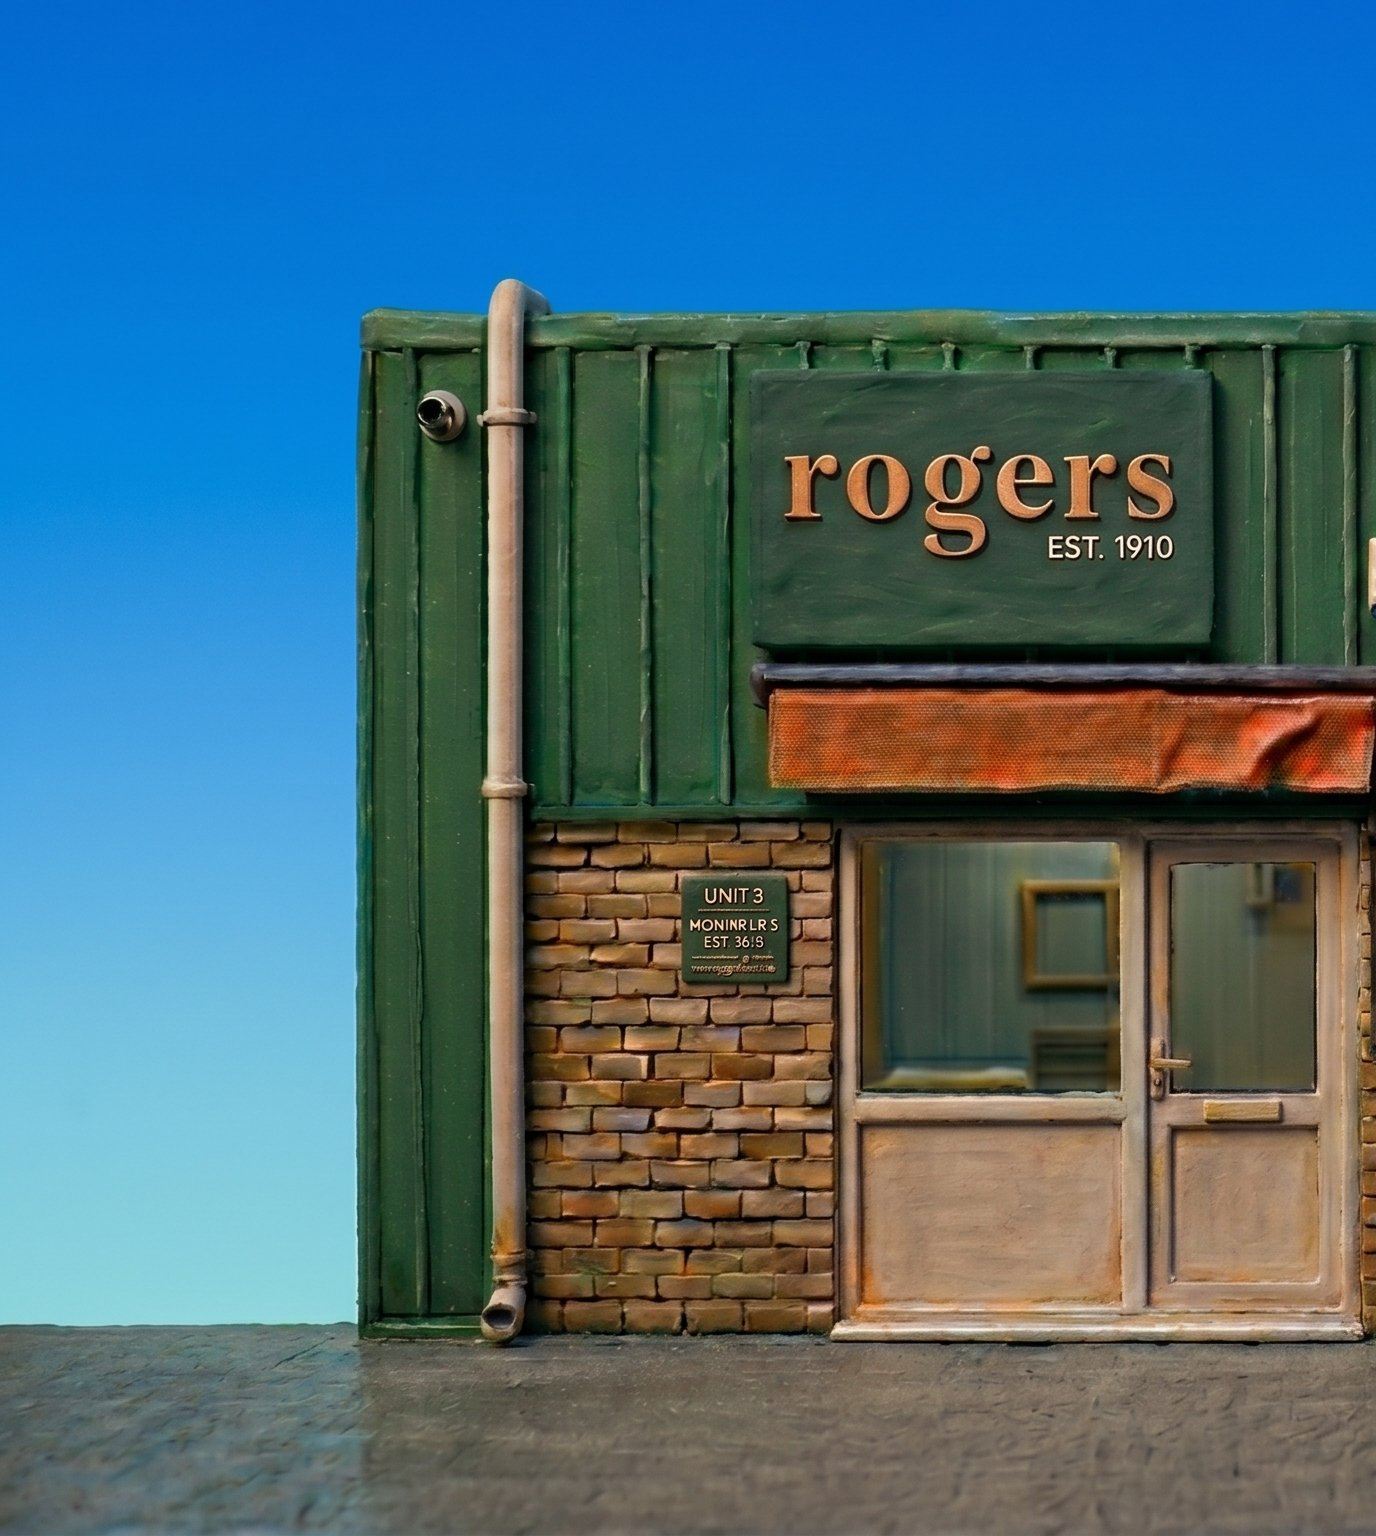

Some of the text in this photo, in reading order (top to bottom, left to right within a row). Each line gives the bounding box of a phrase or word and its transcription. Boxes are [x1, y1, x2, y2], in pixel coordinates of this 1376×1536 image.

[784, 445, 1175, 557] rogers
[1048, 535, 1174, 560] EST. 1910
[704, 887, 764, 904] UNIT 3
